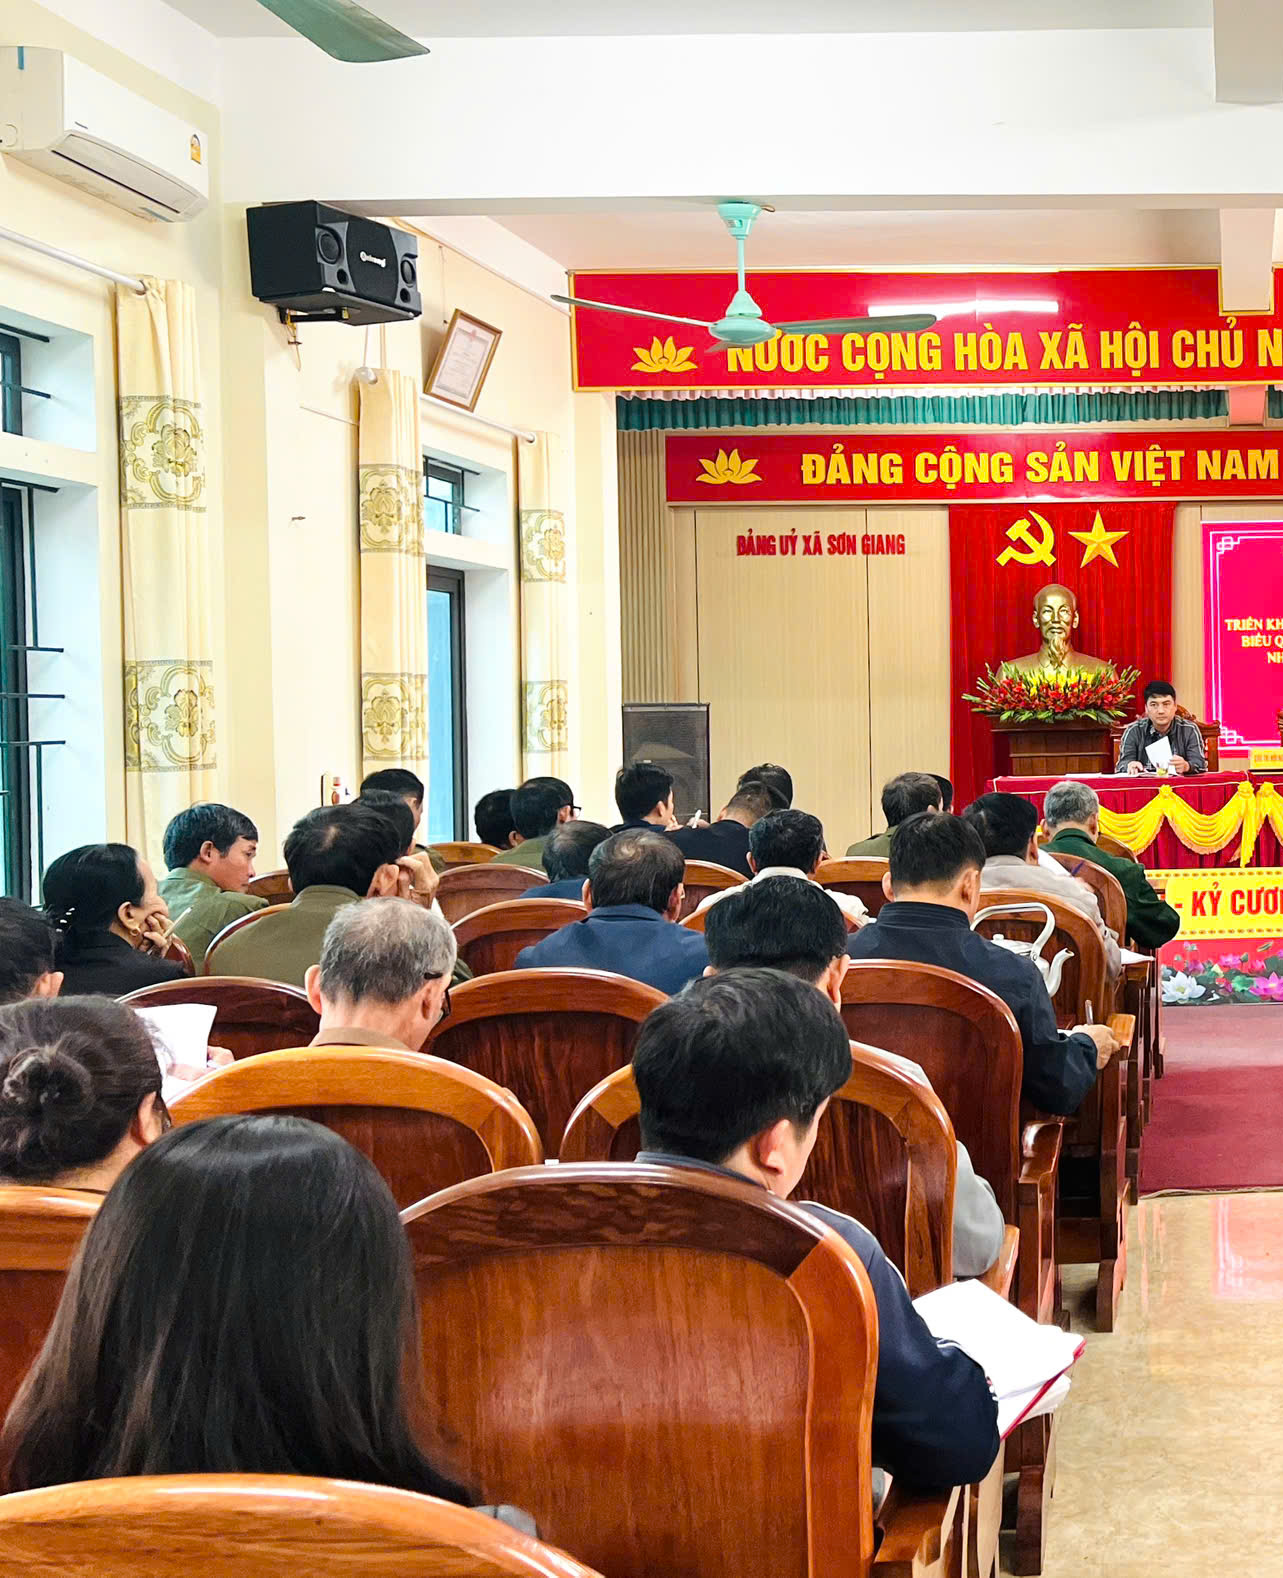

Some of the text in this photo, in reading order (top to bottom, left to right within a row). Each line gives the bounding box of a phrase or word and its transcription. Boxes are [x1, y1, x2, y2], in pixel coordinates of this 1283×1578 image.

[954, 323, 1028, 371] HÒA
[1039, 323, 1089, 370] XÃ
[1101, 321, 1160, 377] HỘI
[1172, 317, 1243, 370] CHỦ
[801, 444, 903, 485] ĐẢNG
[915, 446, 1014, 490] CỘNG
[1026, 441, 1099, 483] SẢN
[1111, 445, 1185, 487] VIỆT
[1197, 449, 1279, 481] NAM
[736, 528, 906, 556] ĐẢNG UỶ XÃ SƠN GIANG
[1191, 881, 1222, 917] KỶ
